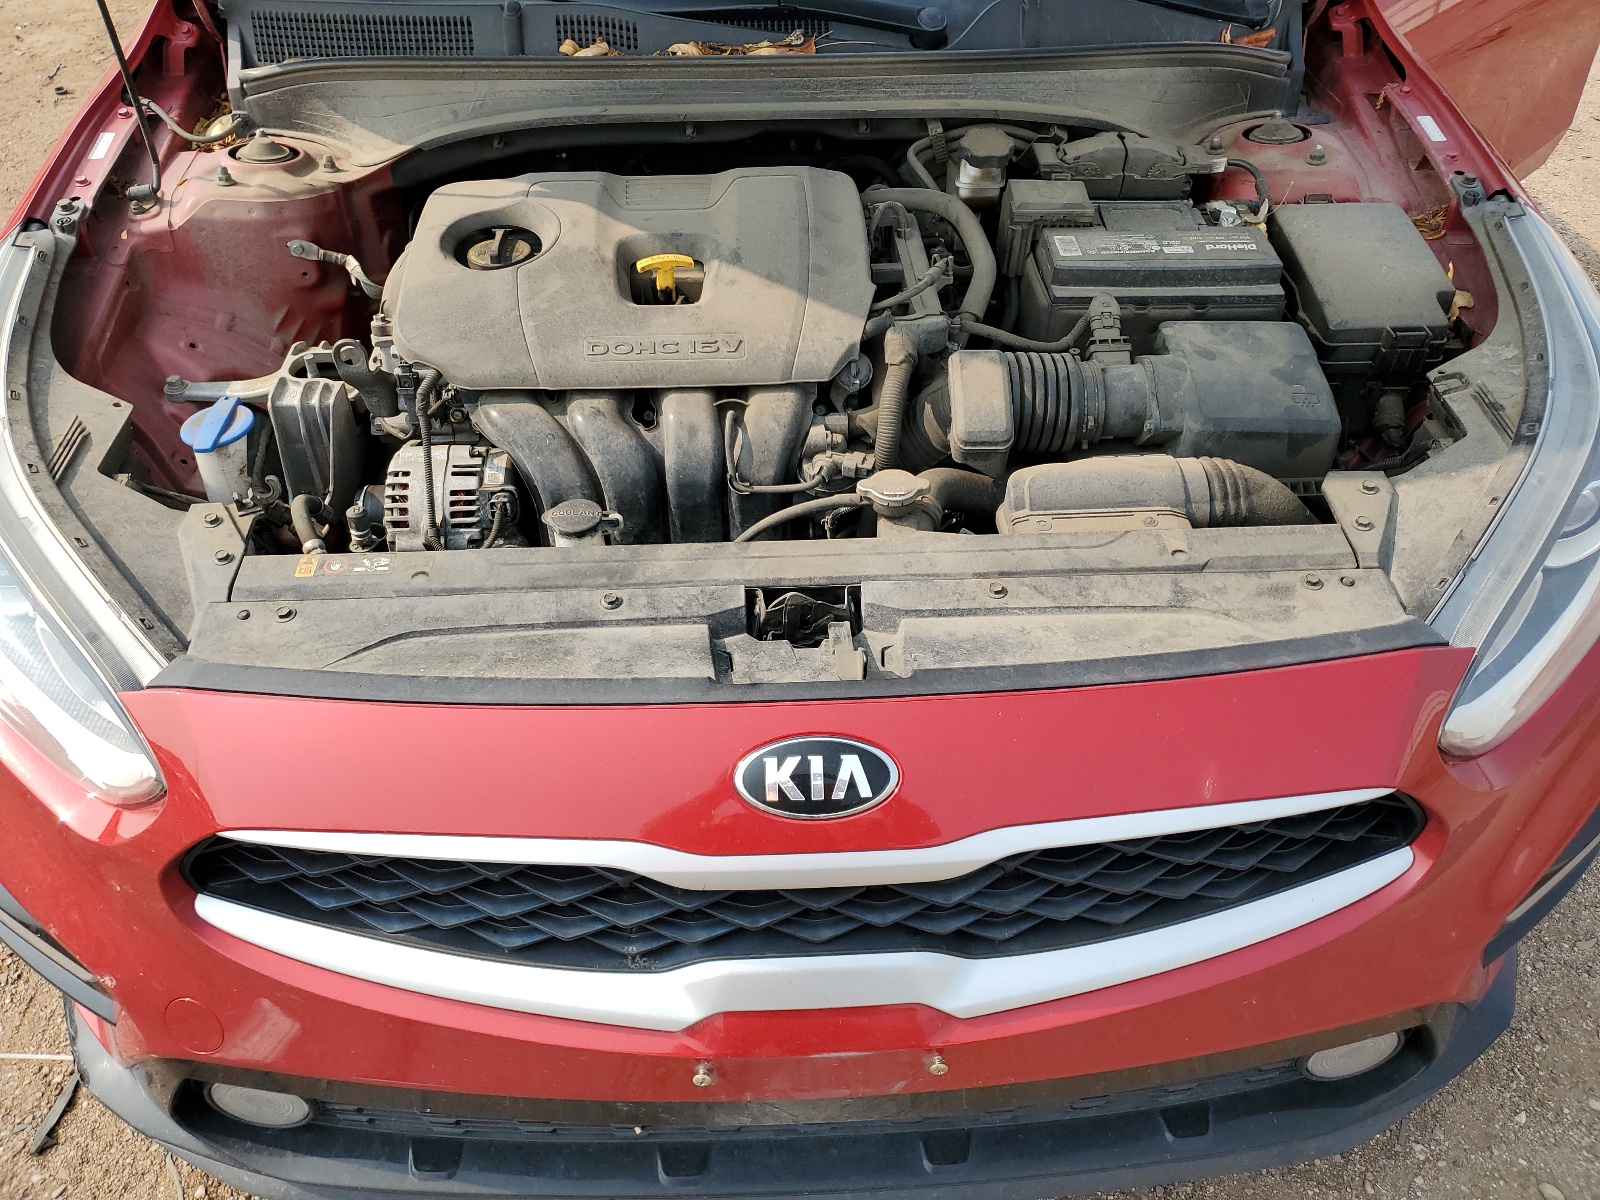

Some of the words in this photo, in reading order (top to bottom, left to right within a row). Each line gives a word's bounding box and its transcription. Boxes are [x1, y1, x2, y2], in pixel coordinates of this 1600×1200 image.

[1205, 243, 1258, 251] DieHard
[586, 341, 680, 356] DOHC
[689, 339, 744, 354] 16V
[551, 509, 602, 518] COOLANT
[762, 754, 873, 801] KIA
